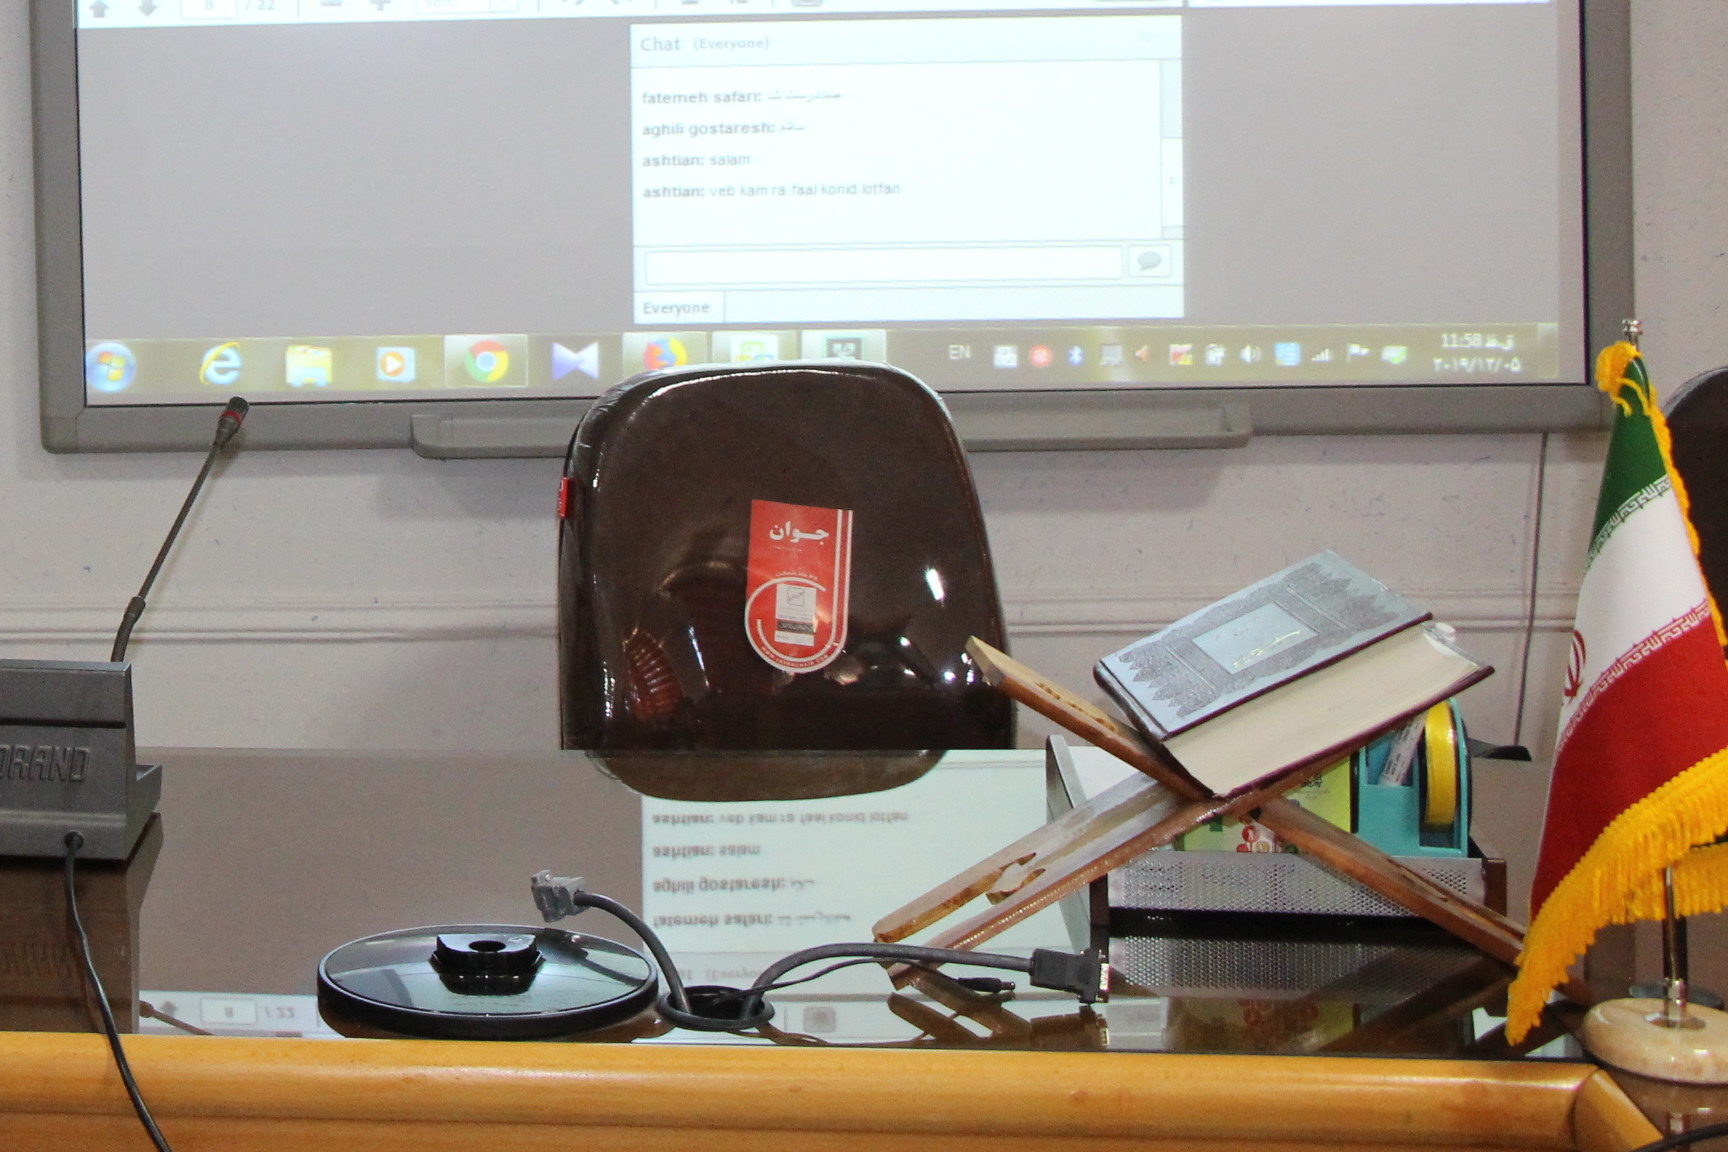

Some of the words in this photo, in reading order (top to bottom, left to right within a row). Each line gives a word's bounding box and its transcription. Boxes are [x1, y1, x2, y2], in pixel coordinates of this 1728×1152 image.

[640, 37, 681, 52] Chat
[693, 36, 770, 52] (Everyone)
[642, 92, 708, 105] fatemeh
[709, 153, 751, 166] salam
[642, 300, 710, 318] Everyone
[949, 345, 971, 360] EN
[769, 520, 830, 545] جوان
